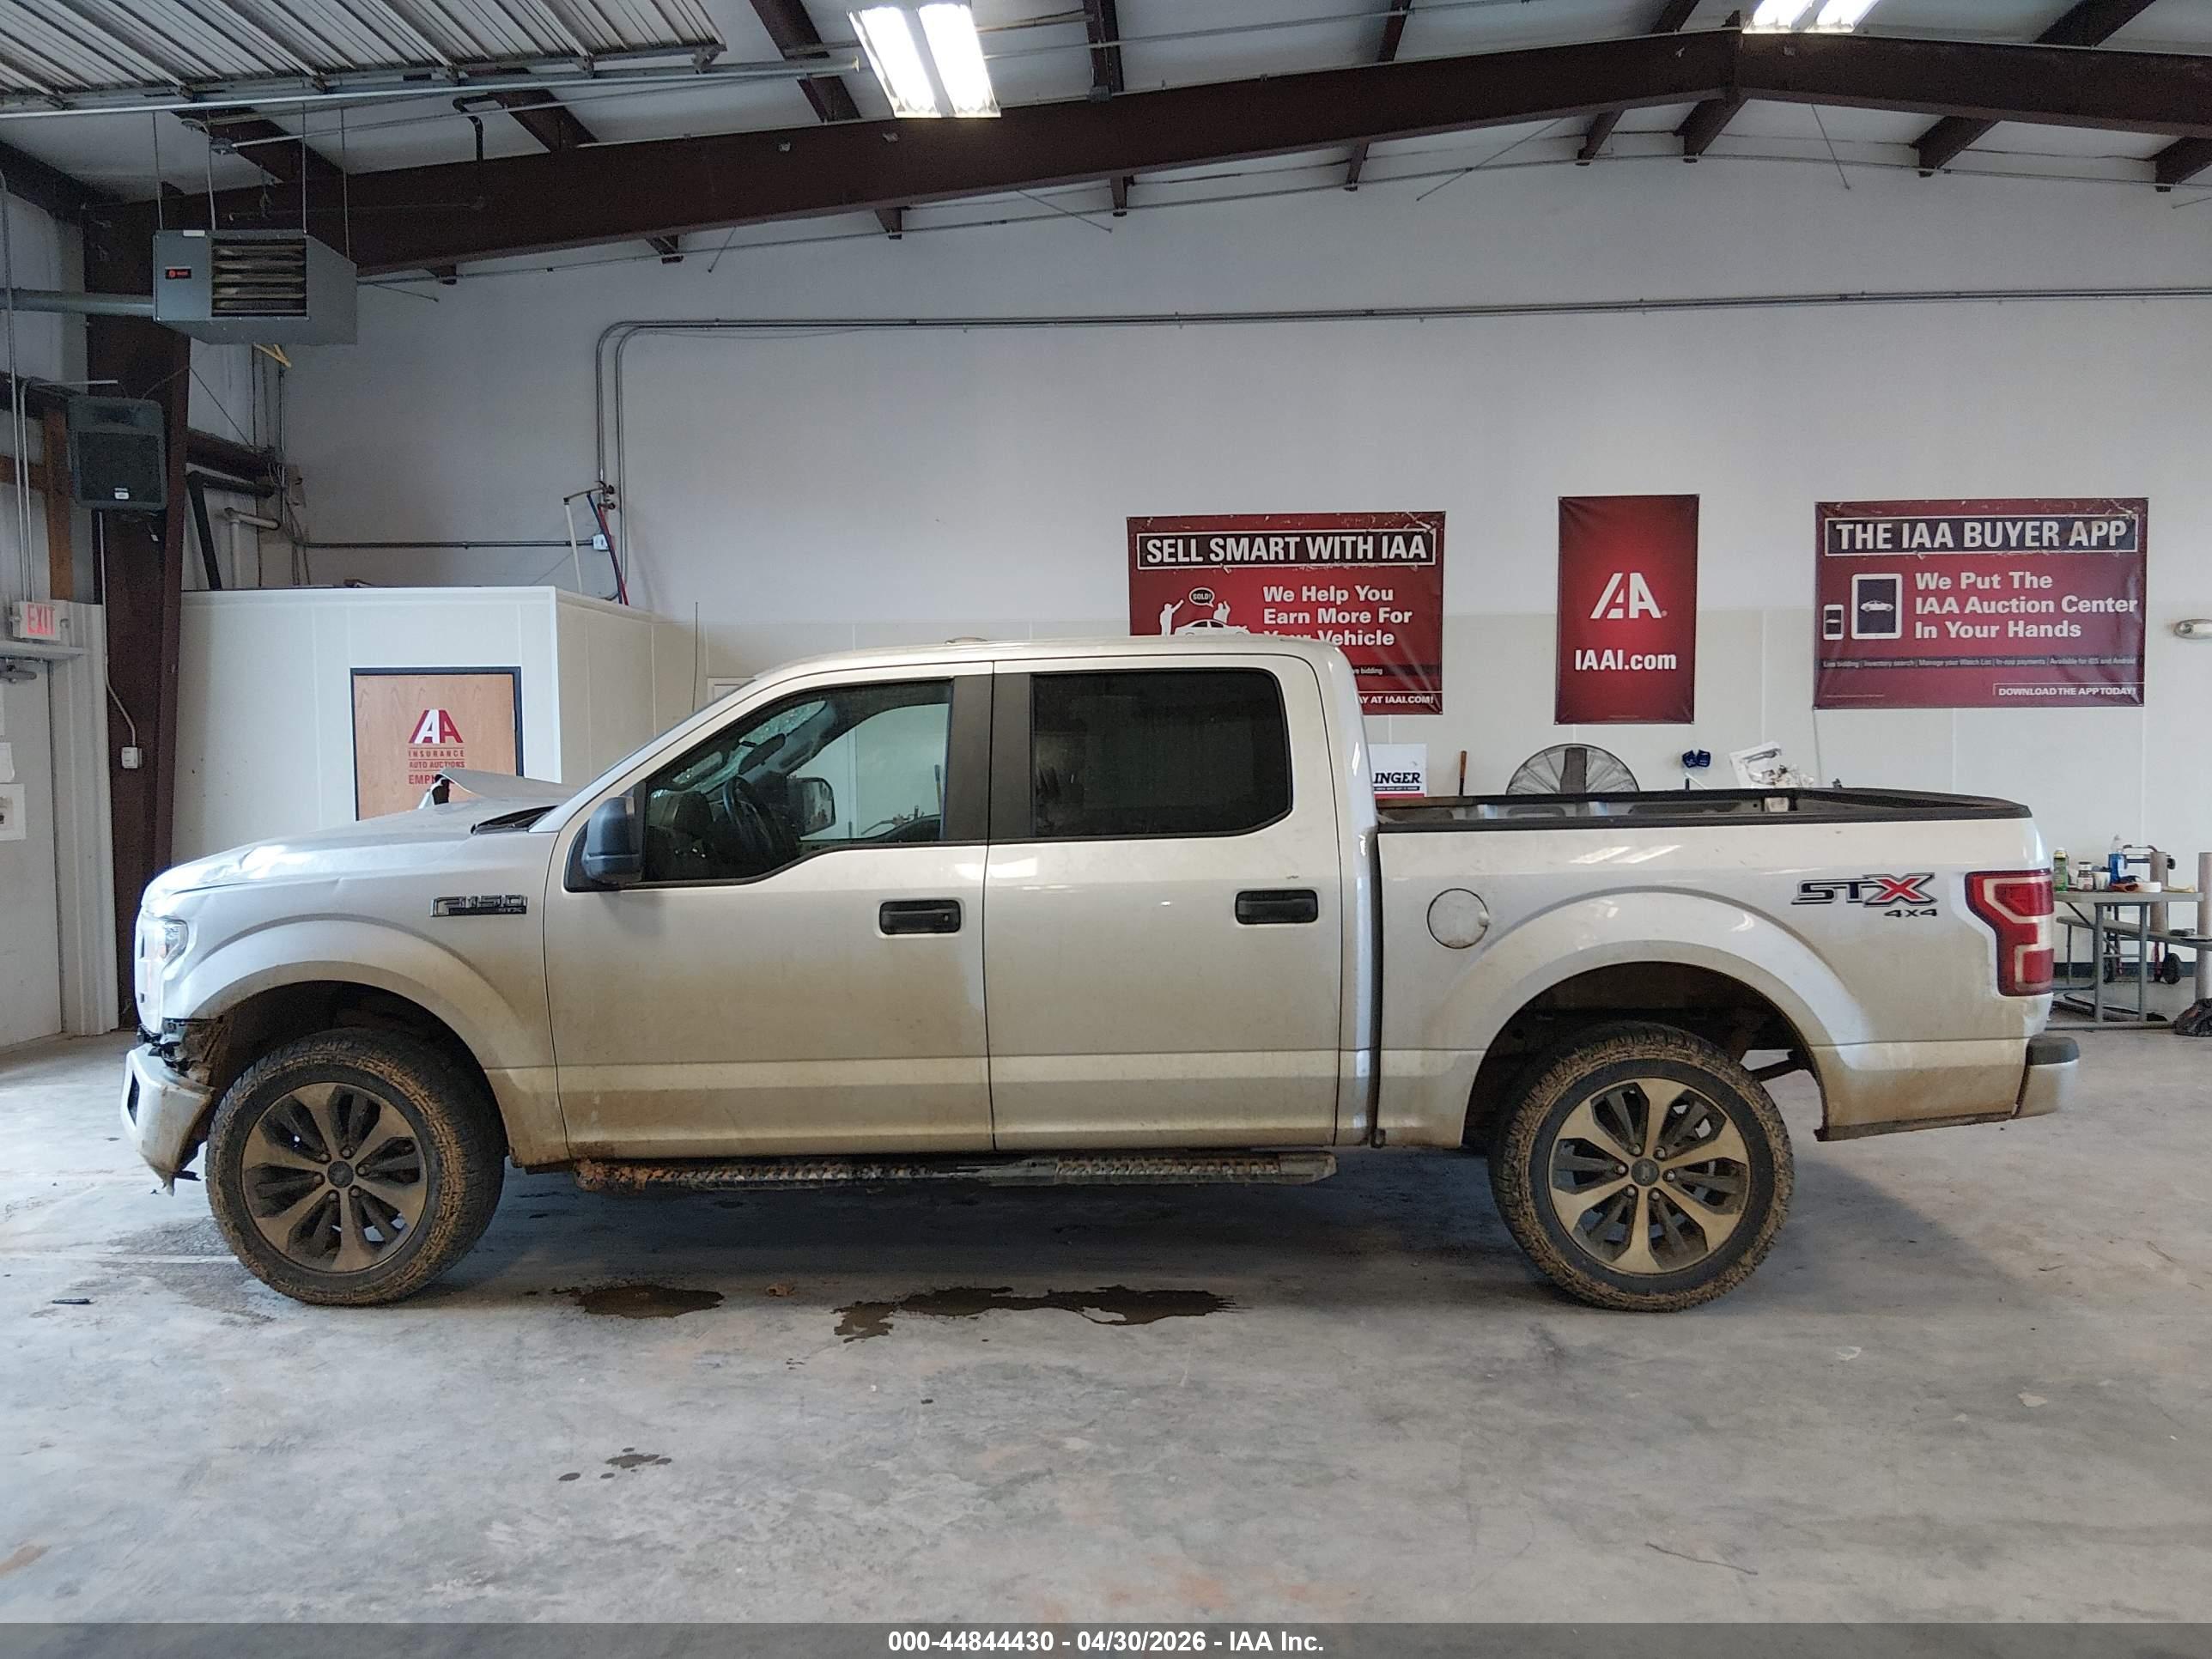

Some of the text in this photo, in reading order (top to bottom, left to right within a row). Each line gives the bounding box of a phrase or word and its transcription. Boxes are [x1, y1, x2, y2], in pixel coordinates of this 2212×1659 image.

[1837, 520, 2127, 550] THE IAA BUYER APP
[1146, 534, 1427, 563] SELL SMART WITH IAA
[1916, 571, 2052, 590] We Put The
[1192, 592, 1212, 601] SOLD!
[1263, 585, 1394, 605] We Help You
[1916, 596, 2137, 615] IAA Auction Center
[27, 604, 56, 635] EXIT
[1264, 607, 1413, 624] Earn More For
[1318, 629, 1395, 646] Vehicle
[1916, 620, 2081, 639] In Your Hands
[1575, 649, 1676, 670] IAAI.com
[2100, 687, 2136, 696] TODAY!
[1374, 772, 1422, 784] INGER
[1790, 872, 1938, 908] STX
